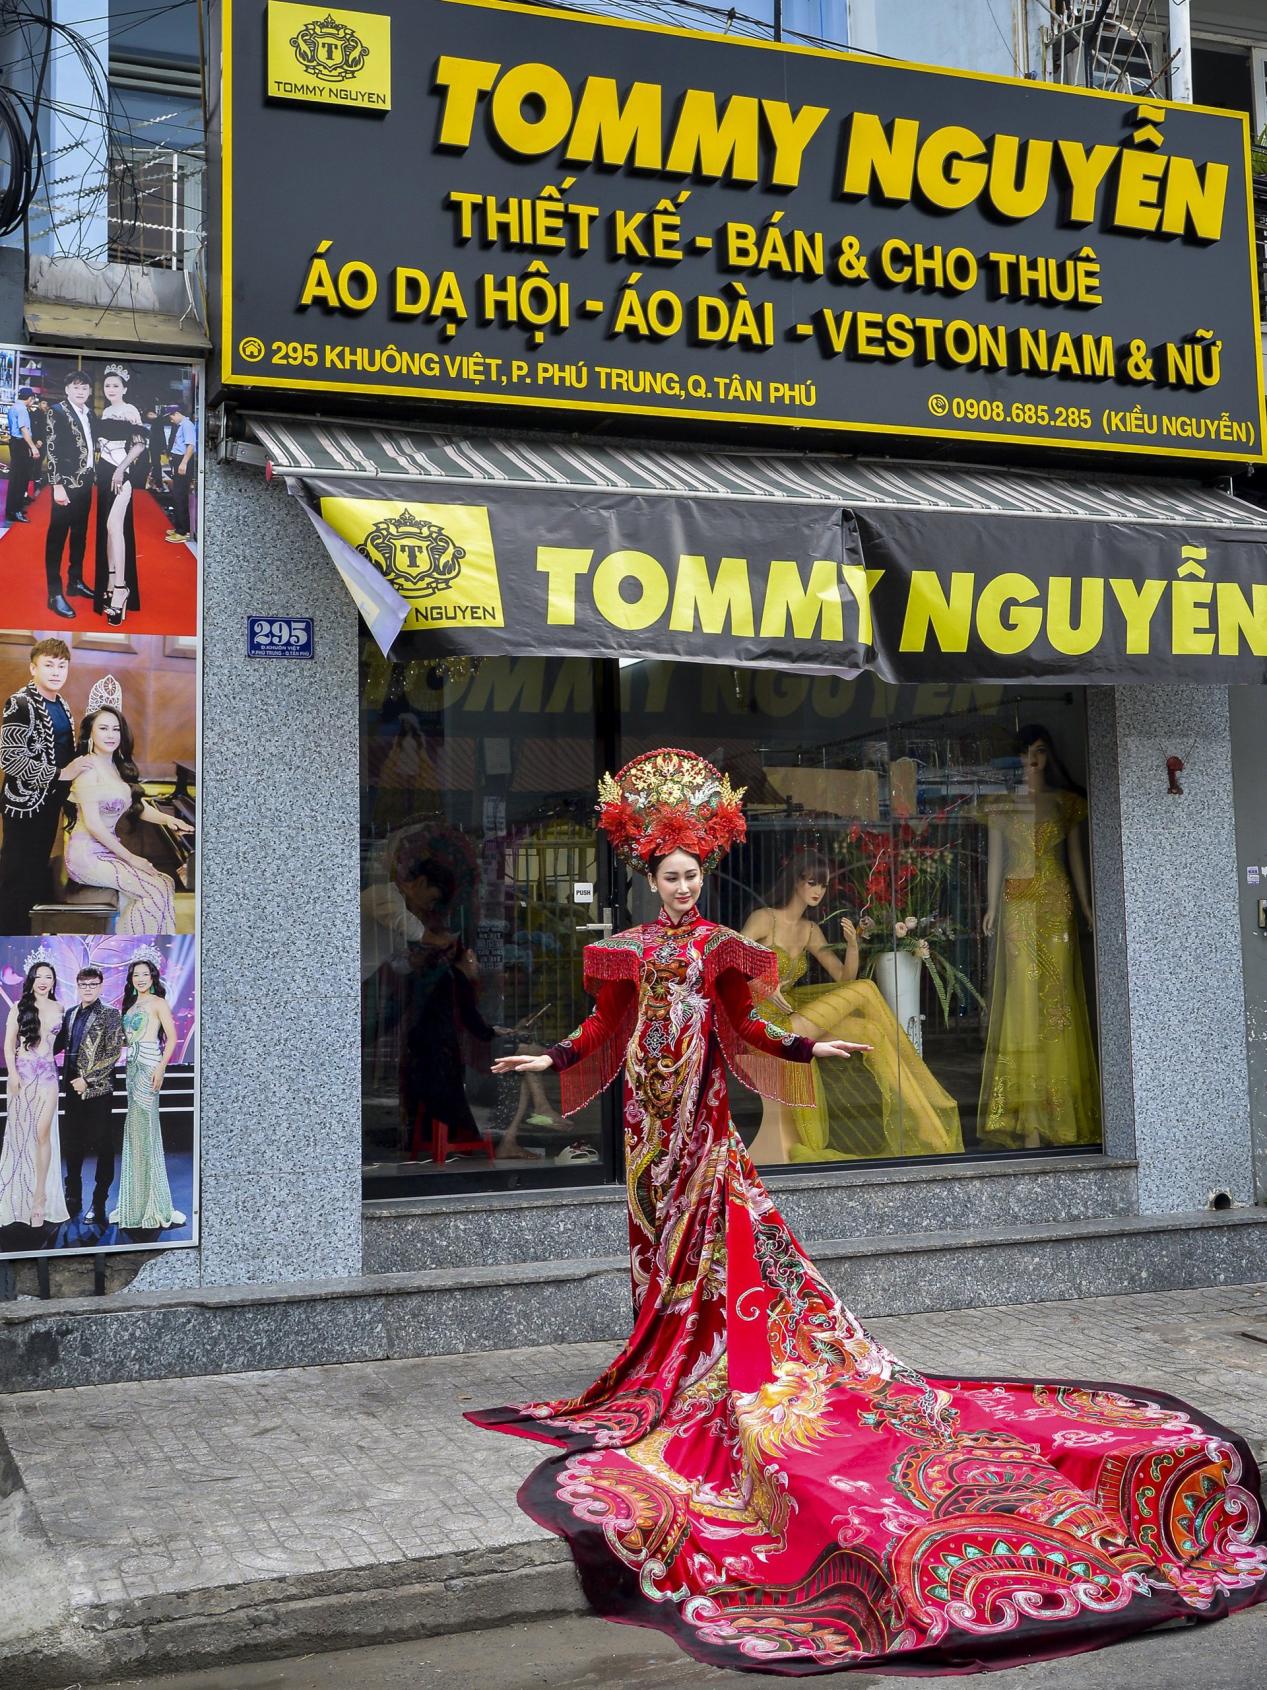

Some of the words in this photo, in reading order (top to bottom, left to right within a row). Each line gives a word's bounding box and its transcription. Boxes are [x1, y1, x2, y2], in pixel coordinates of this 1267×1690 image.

[322, 42, 338, 60] T
[274, 81, 326, 97] TOMMY
[329, 88, 386, 104] NGUYEN
[437, 56, 829, 188] TOMMY
[844, 105, 1228, 239] NGUYỄN
[451, 177, 599, 249] THIẾT
[616, 191, 691, 259] KẾ
[728, 211, 823, 274] BÁN
[839, 236, 868, 278] &
[882, 239, 977, 290] CHO
[990, 247, 1102, 303] THUÊ
[301, 240, 377, 309] ÁO
[397, 267, 467, 335] DẠ
[485, 260, 569, 342] HỘI
[615, 272, 682, 335] ÁO
[698, 282, 773, 345] DÀI
[823, 309, 1007, 366] VESTON
[1020, 328, 1114, 376] NAM
[1128, 339, 1154, 379] &
[1167, 329, 1222, 386] NỮ
[272, 342, 318, 366] 295
[326, 345, 439, 376] KHUÔNG
[538, 361, 587, 388] PHÚ
[769, 381, 816, 406] PHÚ
[952, 398, 1091, 428] 0908.685.285
[1103, 405, 1157, 434] (KIỀU
[1162, 413, 1254, 445] NGUYỄN)
[400, 545, 423, 568] T
[415, 606, 496, 622] NGUYEN
[537, 547, 884, 645] TOMMY
[900, 546, 1267, 656] NGUYỄN
[254, 621, 308, 646] 295
